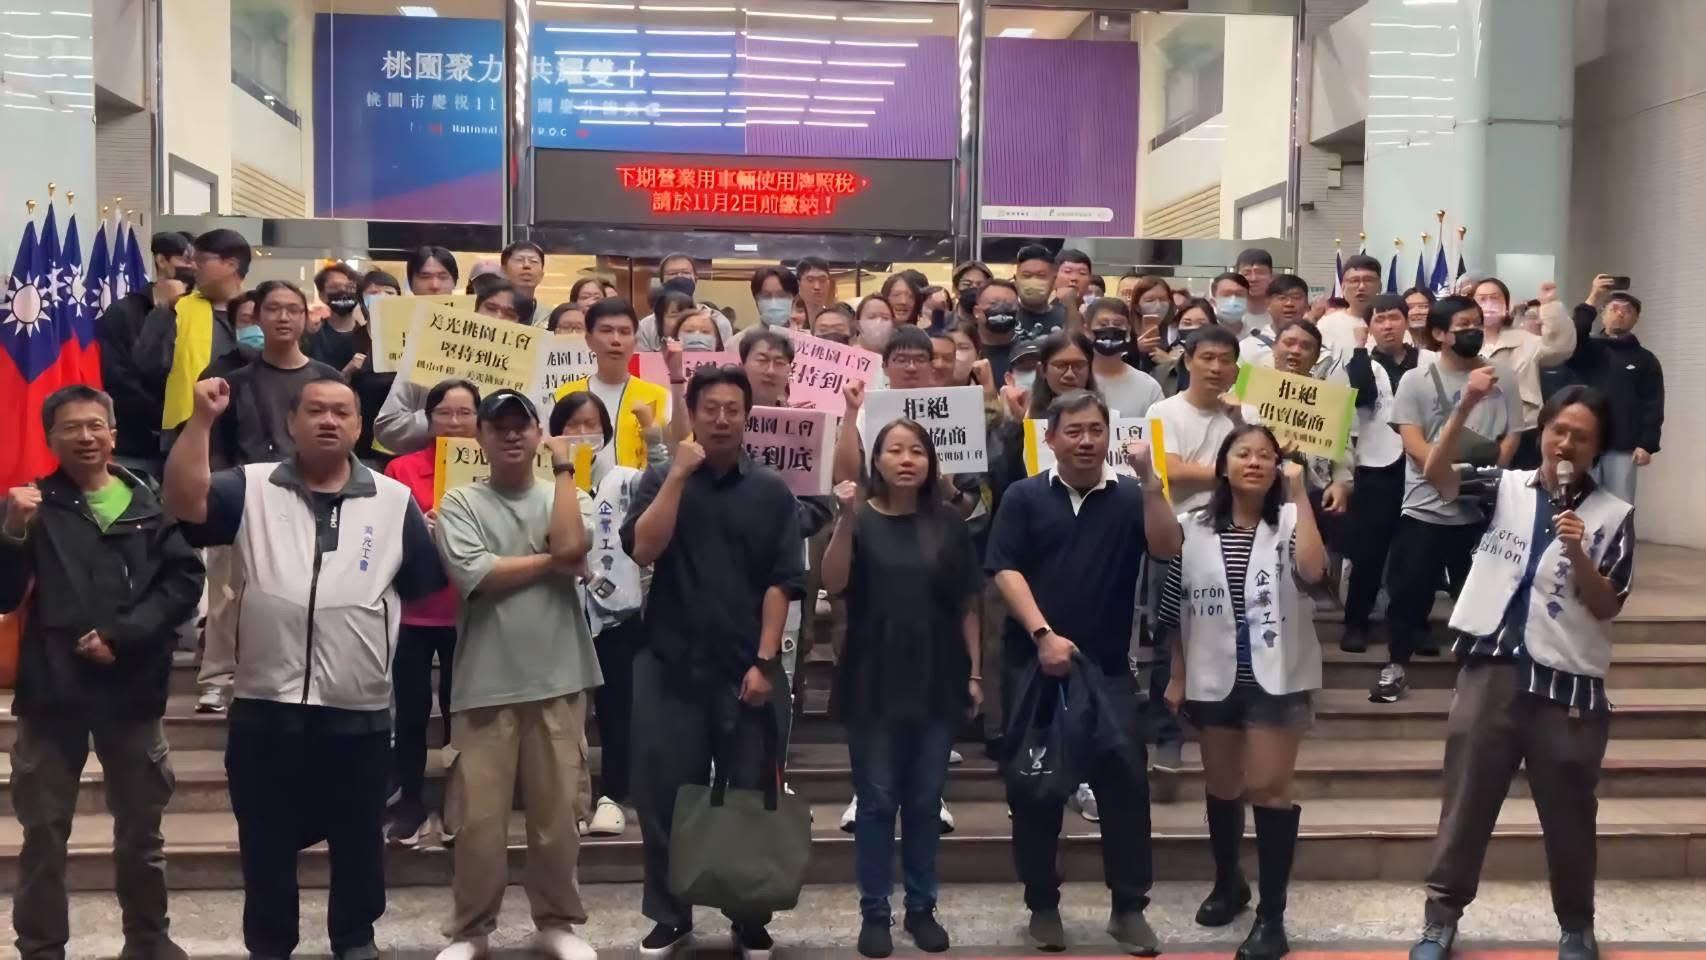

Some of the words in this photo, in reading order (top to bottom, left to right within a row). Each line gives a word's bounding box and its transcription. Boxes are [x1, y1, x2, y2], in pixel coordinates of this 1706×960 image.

[381, 51, 503, 82] 桃園聚力
[440, 340, 512, 371] 堅持到底
[1278, 379, 1319, 406] 拒絕
[903, 396, 949, 420] 拒絕
